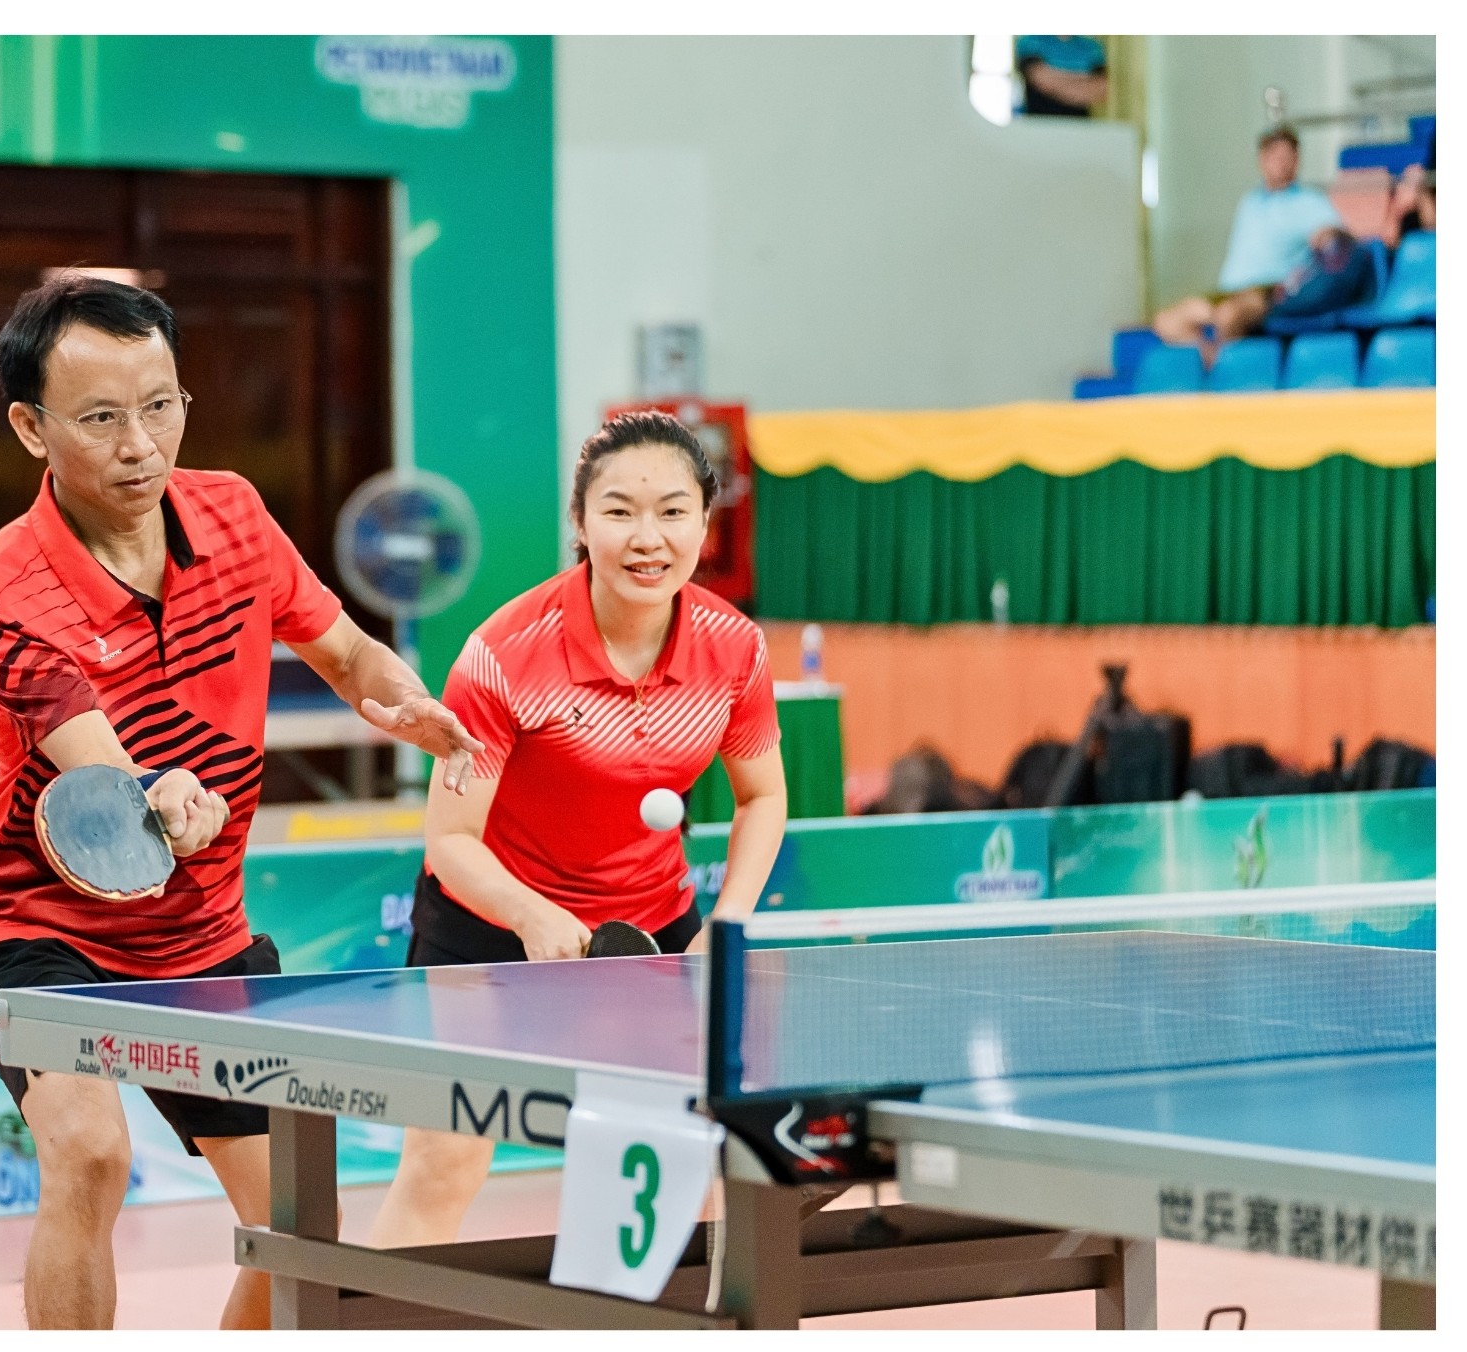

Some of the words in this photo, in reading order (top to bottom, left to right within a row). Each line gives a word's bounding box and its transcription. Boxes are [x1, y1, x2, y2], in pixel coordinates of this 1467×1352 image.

[74, 1058, 101, 1075] Double
[129, 1041, 200, 1078] 中国乒乓
[286, 1077, 345, 1111] Double
[349, 1088, 388, 1116] FISH
[618, 1142, 661, 1269] 3
